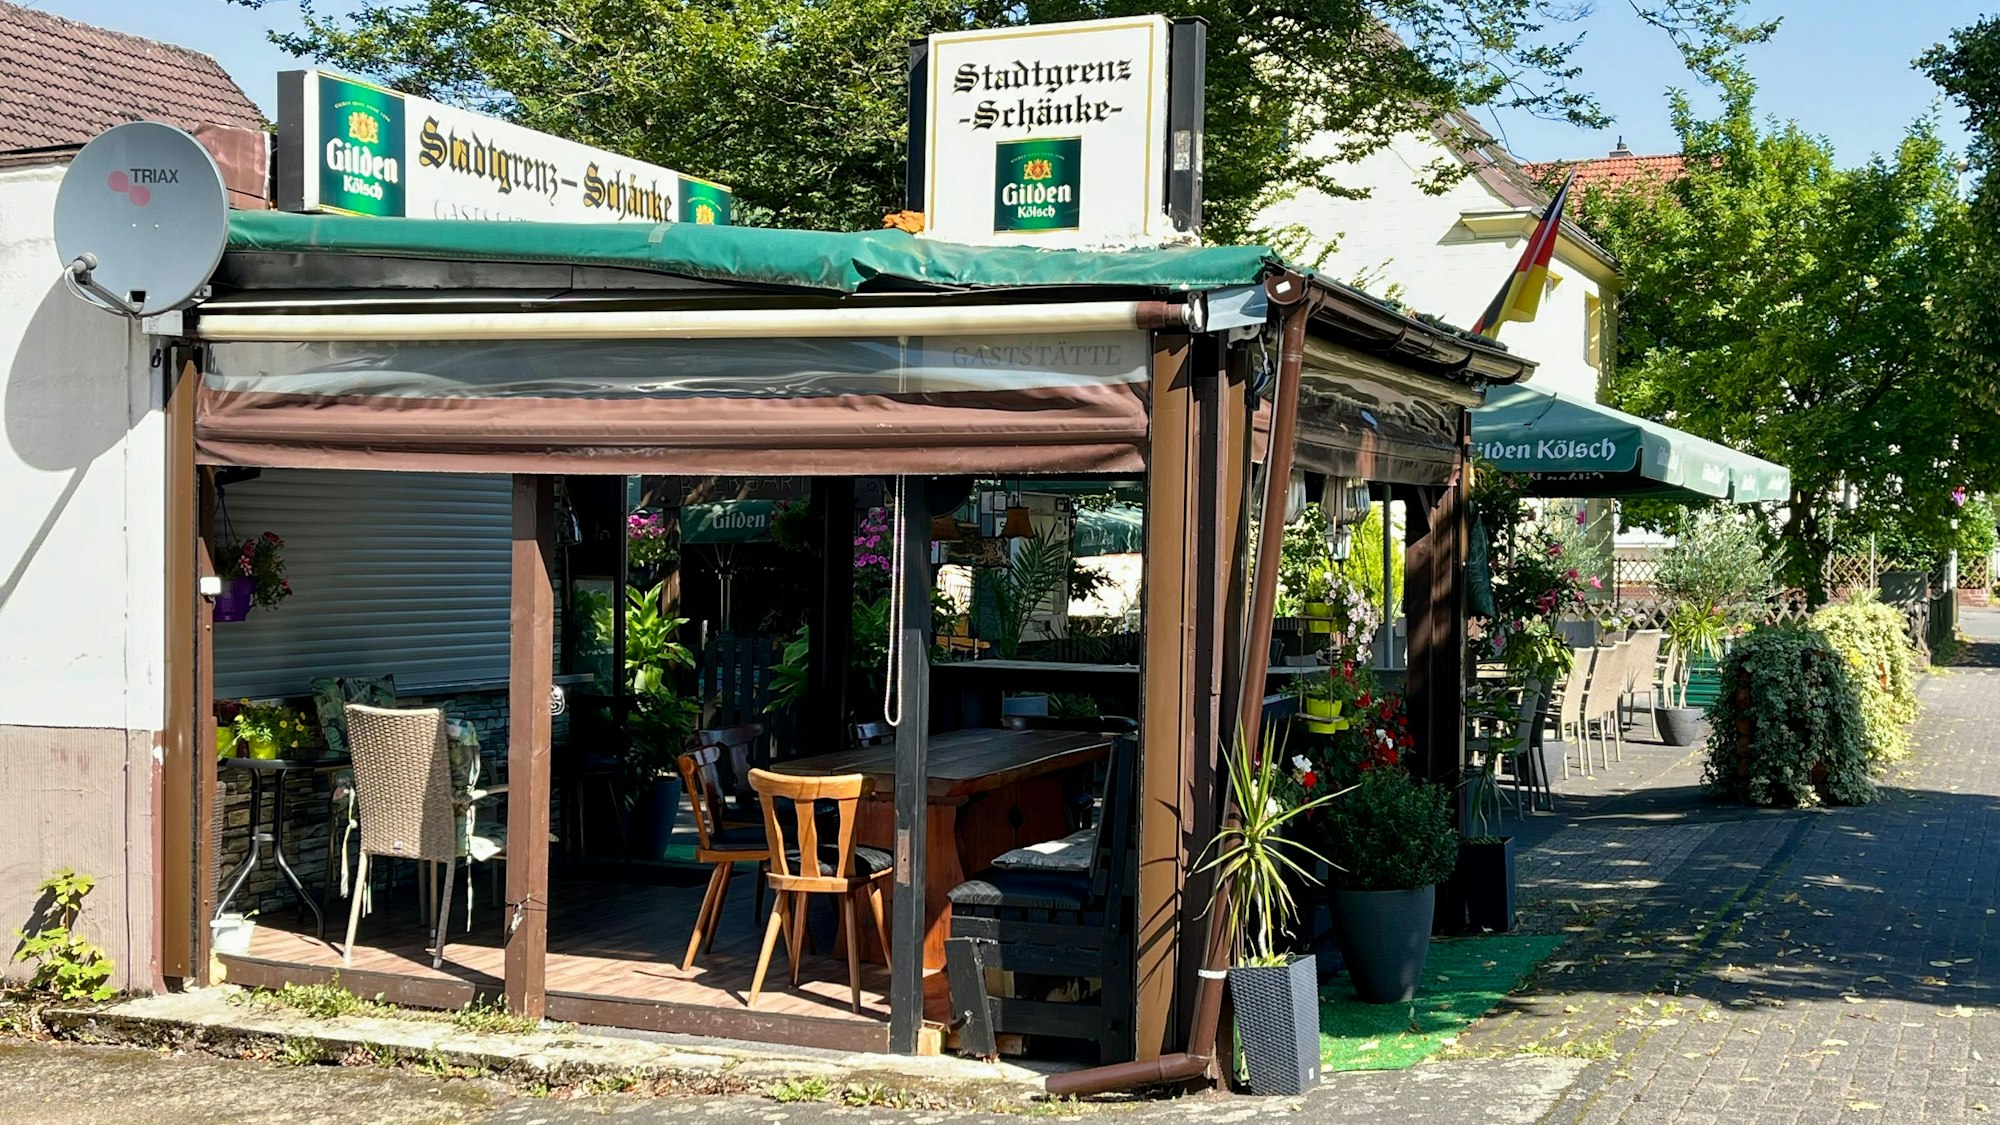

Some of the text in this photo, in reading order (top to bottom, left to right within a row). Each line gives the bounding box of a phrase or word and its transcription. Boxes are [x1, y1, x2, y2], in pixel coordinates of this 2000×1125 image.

[953, 59, 1133, 94] Stadtgrenz
[326, 137, 399, 184] Gilden
[130, 168, 179, 184] TRIAX
[342, 174, 383, 201] Kölsch
[1002, 182, 1072, 206] Gilden
[1018, 205, 1056, 219] Kölsch
[952, 341, 1121, 367] GASTSTÄTTE
[1471, 438, 1616, 461] ilden Kölsch
[712, 511, 766, 529] Gilden
